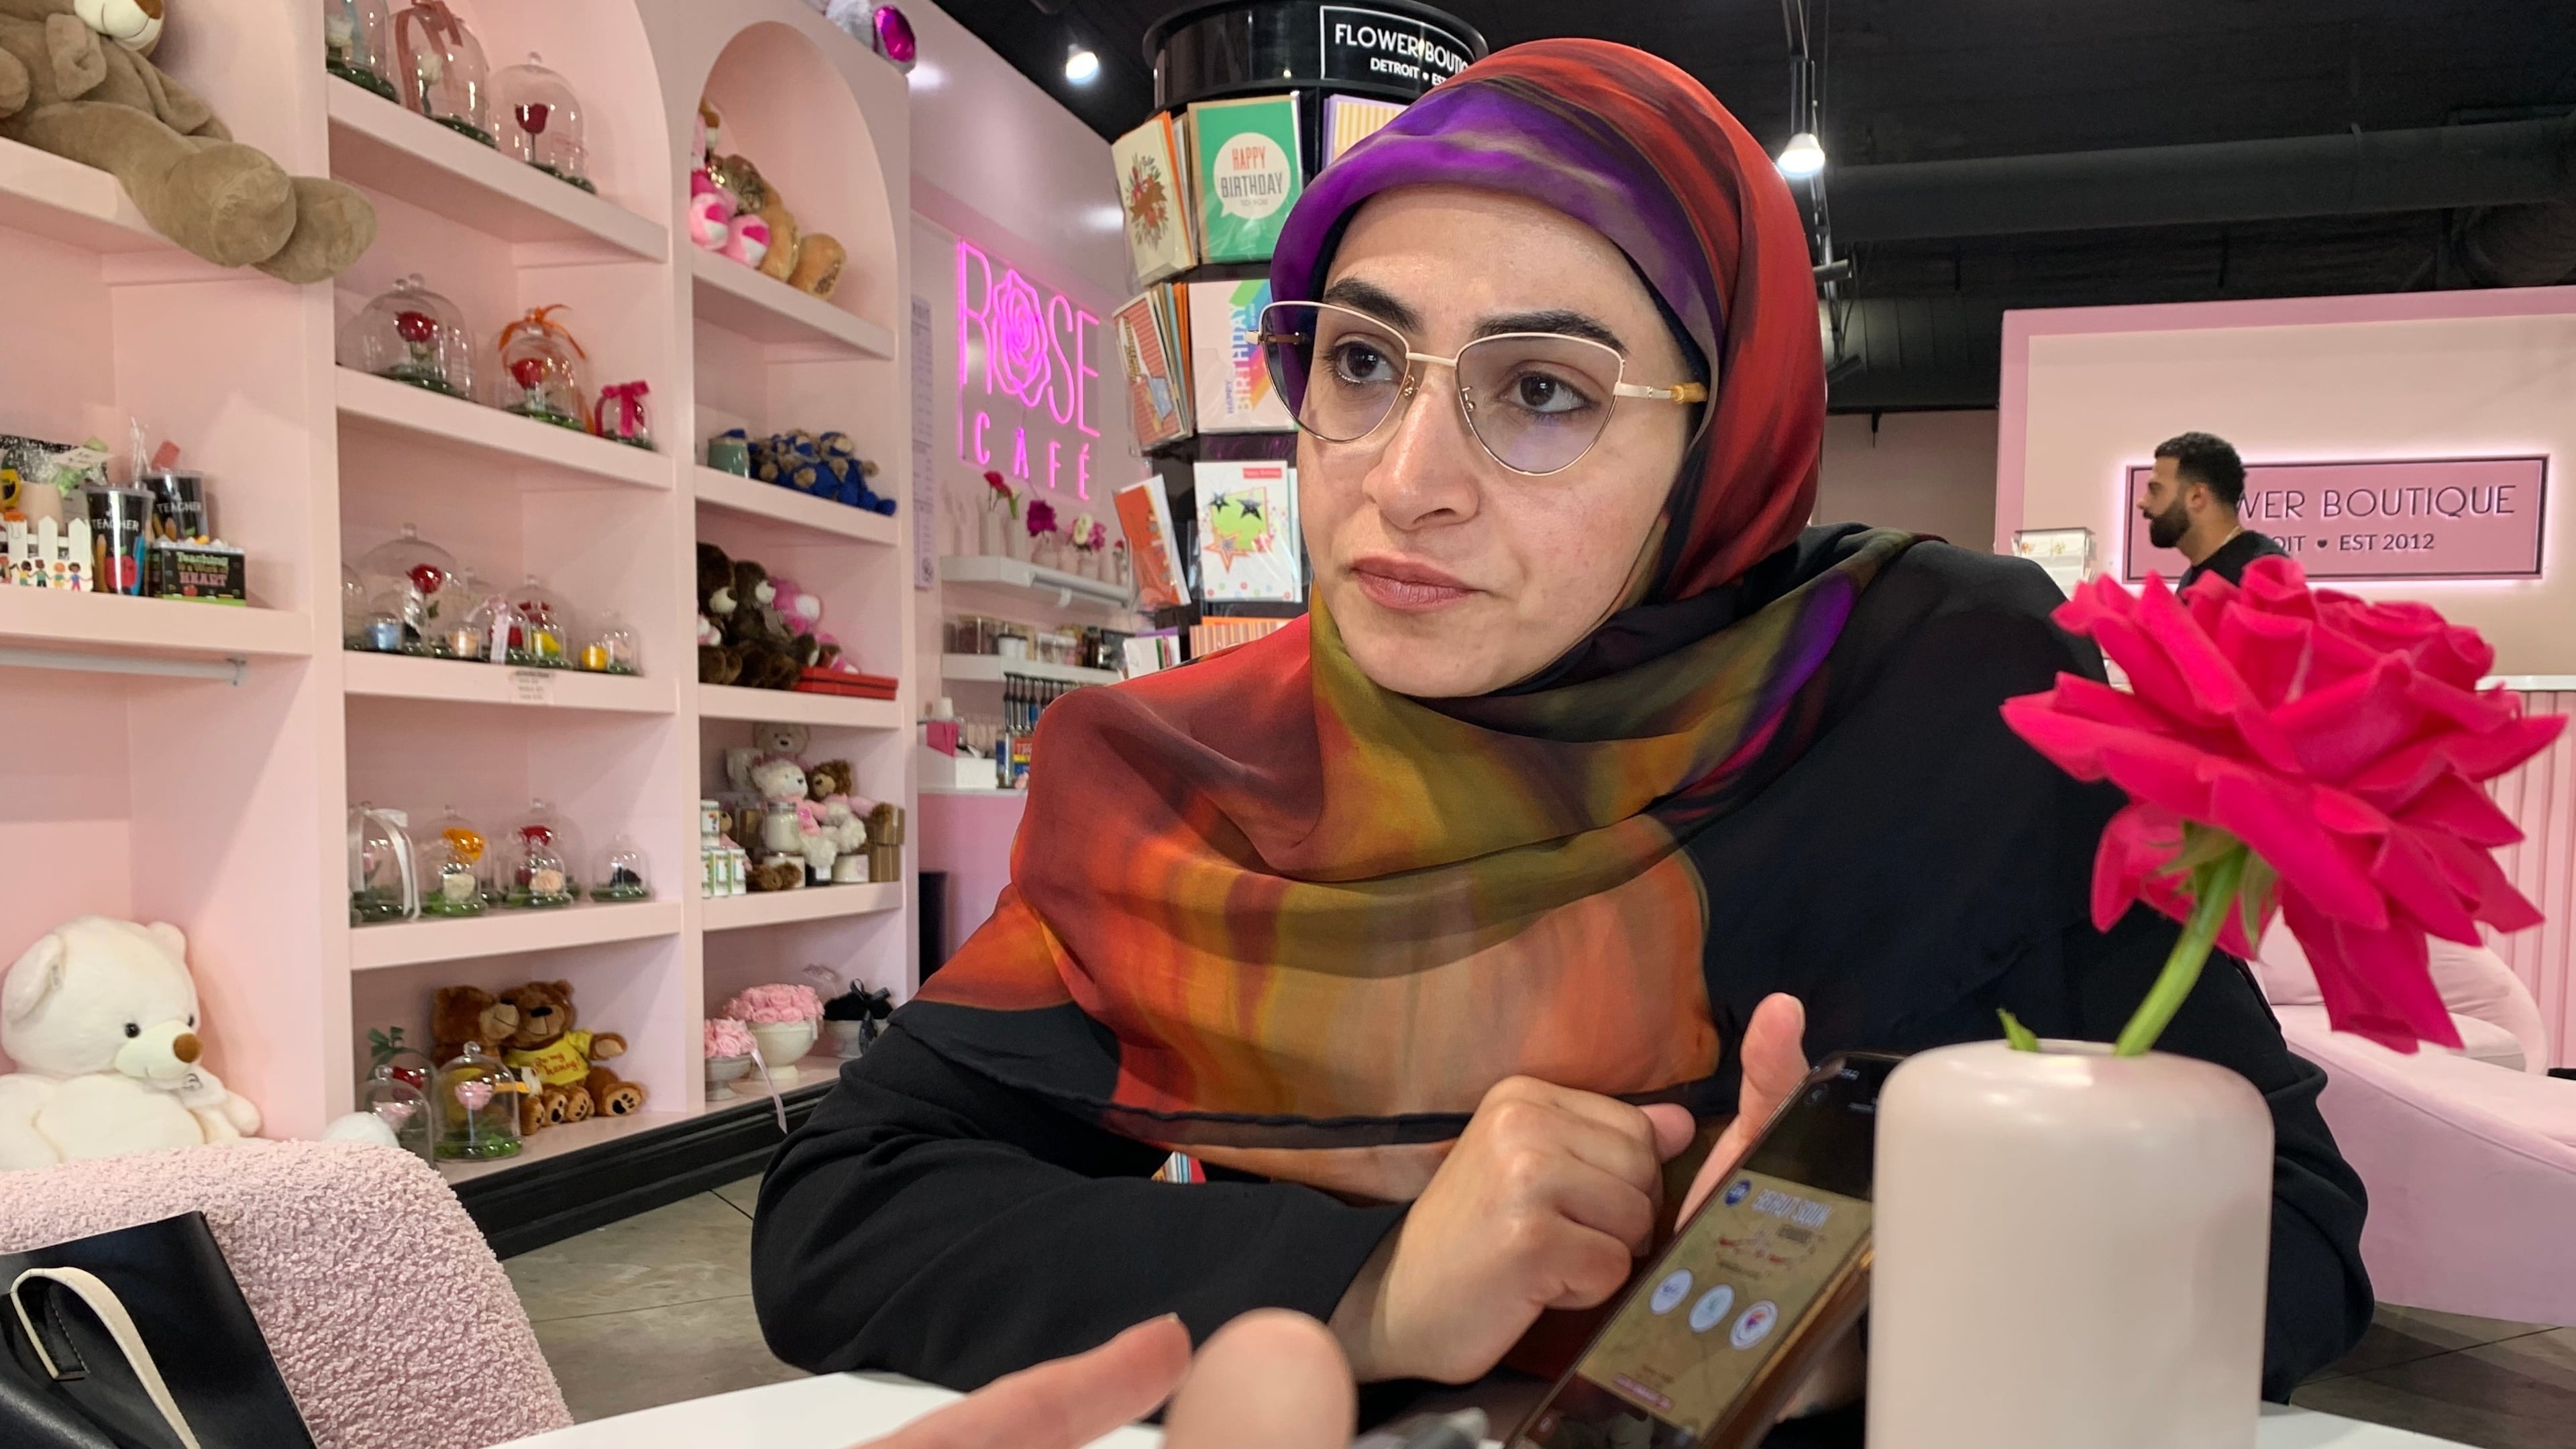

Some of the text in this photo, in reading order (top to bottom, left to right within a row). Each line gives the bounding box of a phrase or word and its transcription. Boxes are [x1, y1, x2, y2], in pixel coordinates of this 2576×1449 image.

[1335, 23, 1469, 75] FLOWER BOUTI
[1371, 57, 1420, 79] DETROIT
[1232, 146, 1266, 170] HAPPY
[1221, 172, 1283, 198] BIRTHDAY
[959, 241, 1100, 437] ROSE
[1230, 306, 1252, 411] BIRTHDAY
[975, 411, 1090, 501] CAFÉ
[2323, 485, 2517, 518] BOUTIQUE
[2339, 533, 2434, 551] EST 2012
